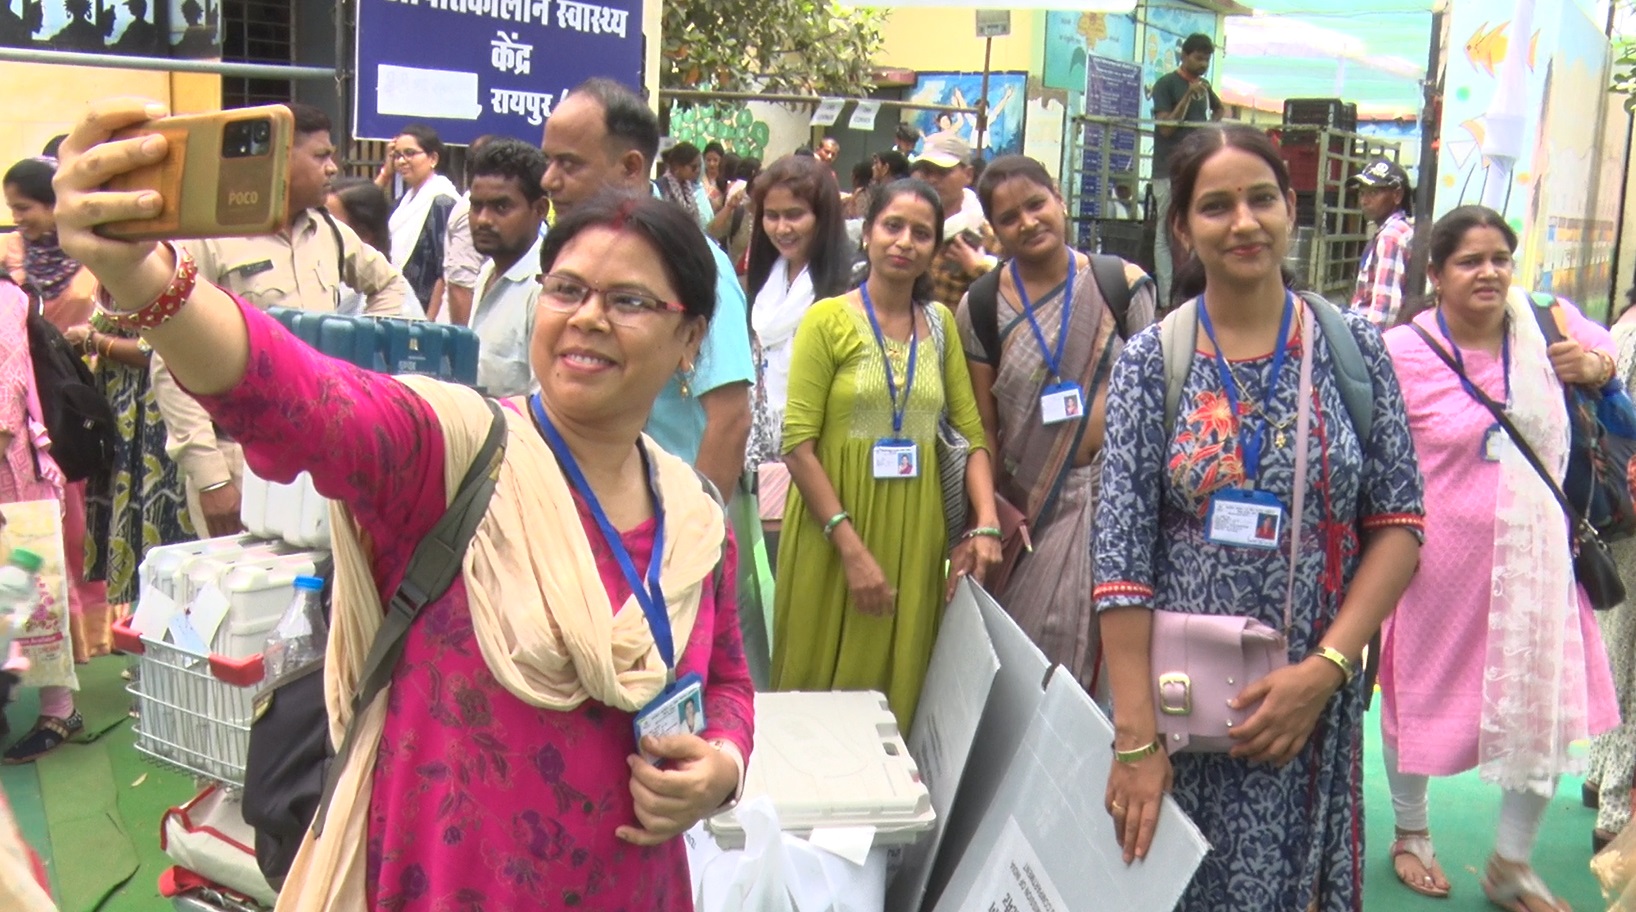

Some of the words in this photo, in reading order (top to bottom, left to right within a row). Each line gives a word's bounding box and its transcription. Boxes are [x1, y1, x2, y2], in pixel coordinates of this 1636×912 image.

[556, 1, 629, 38] स्वास्थ्य
[490, 31, 533, 75] केंद्र
[490, 88, 553, 125] रायपुर
[228, 190, 259, 206] POCO
